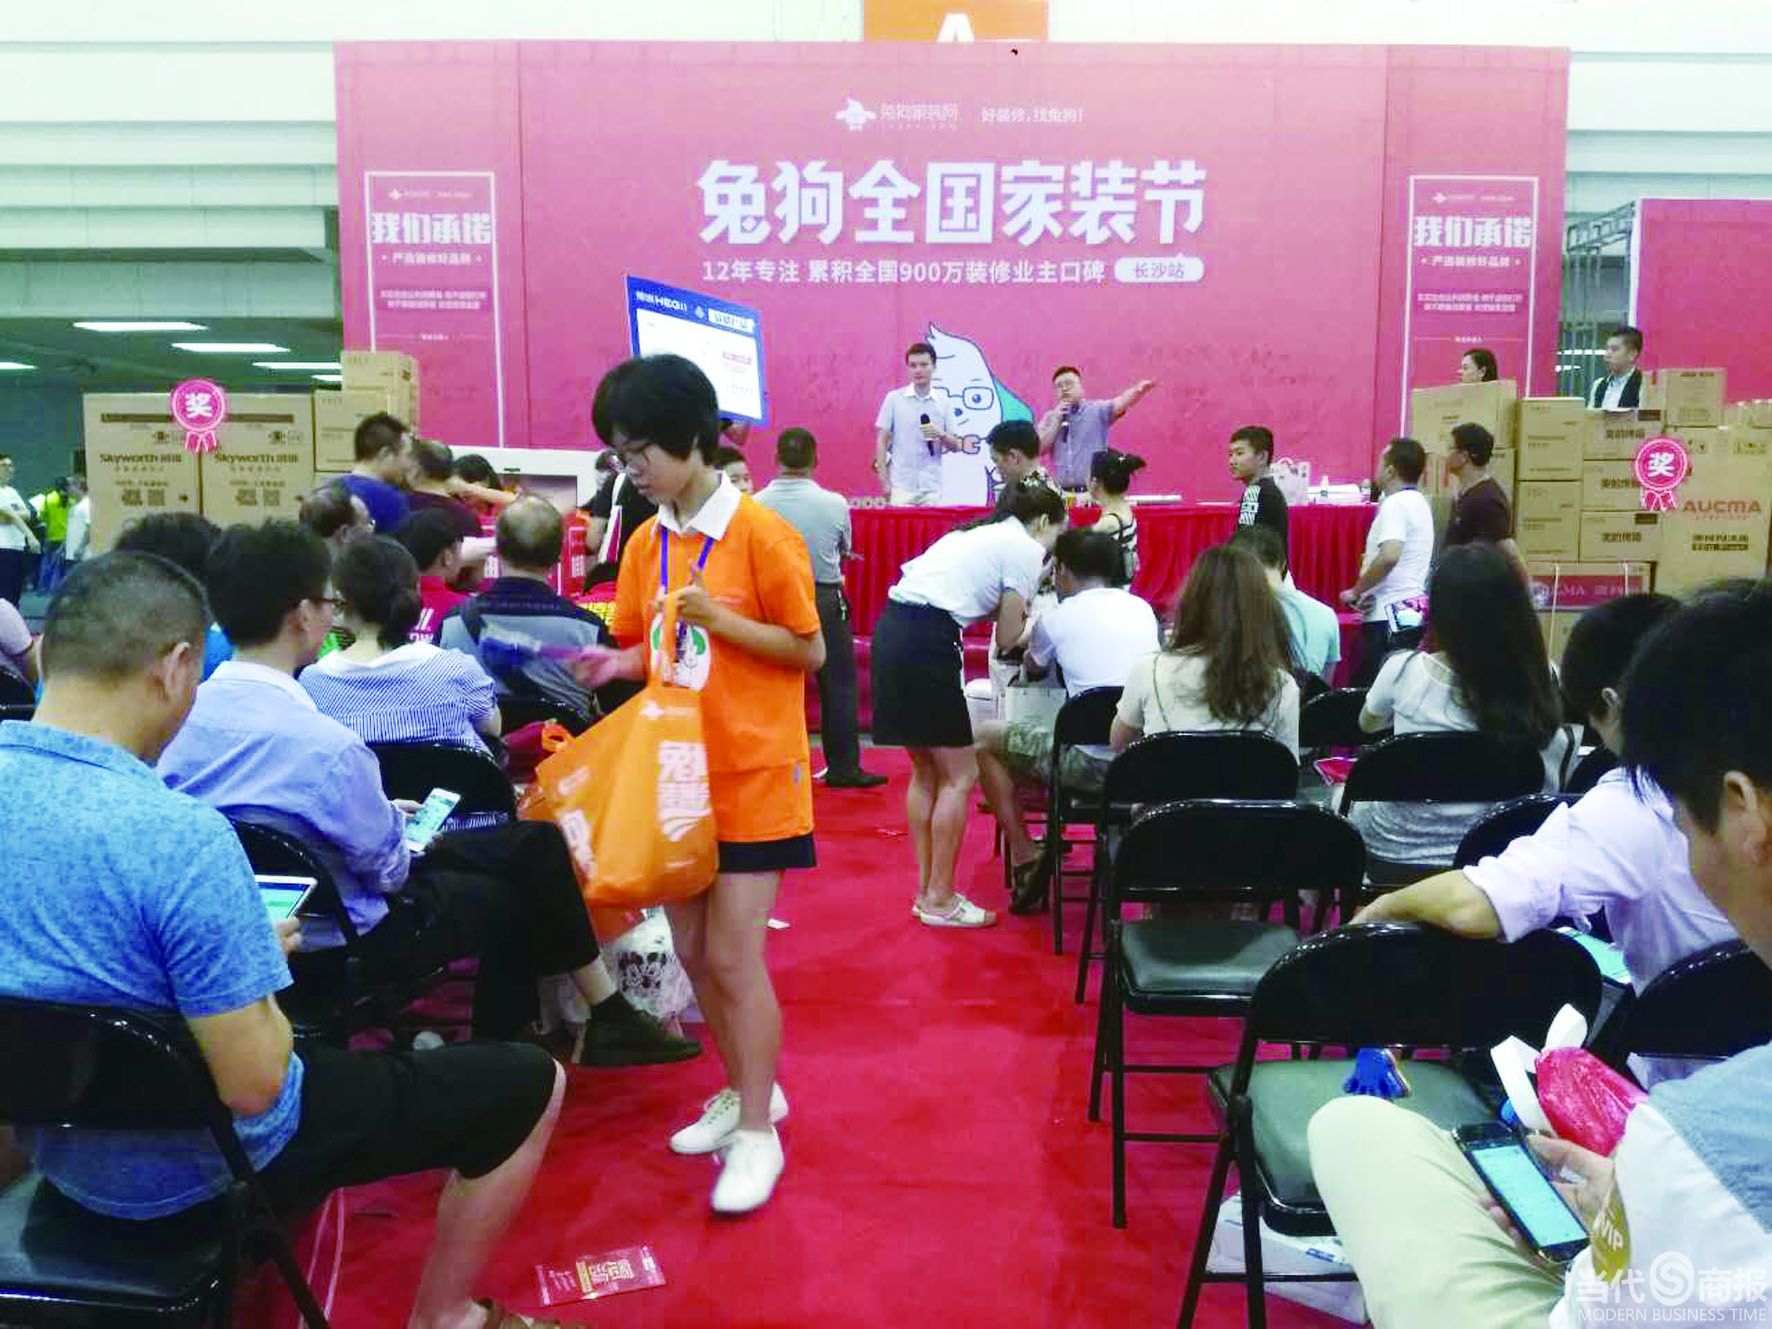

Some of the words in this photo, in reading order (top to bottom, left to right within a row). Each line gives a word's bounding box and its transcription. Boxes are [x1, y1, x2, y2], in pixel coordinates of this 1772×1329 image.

[697, 159, 1207, 246] 兔狗全国家装节
[371, 212, 492, 245] 我们承诺
[1413, 216, 1532, 248] 我们承诺
[702, 259, 801, 284] 12年专注
[808, 258, 1105, 285] 累积全国900万装修业主口碑
[1131, 261, 1186, 280] 长沙站
[185, 392, 213, 419] 奖
[99, 453, 158, 464] Skyworth
[215, 453, 277, 465] Skyworth
[1648, 451, 1675, 478] 奖
